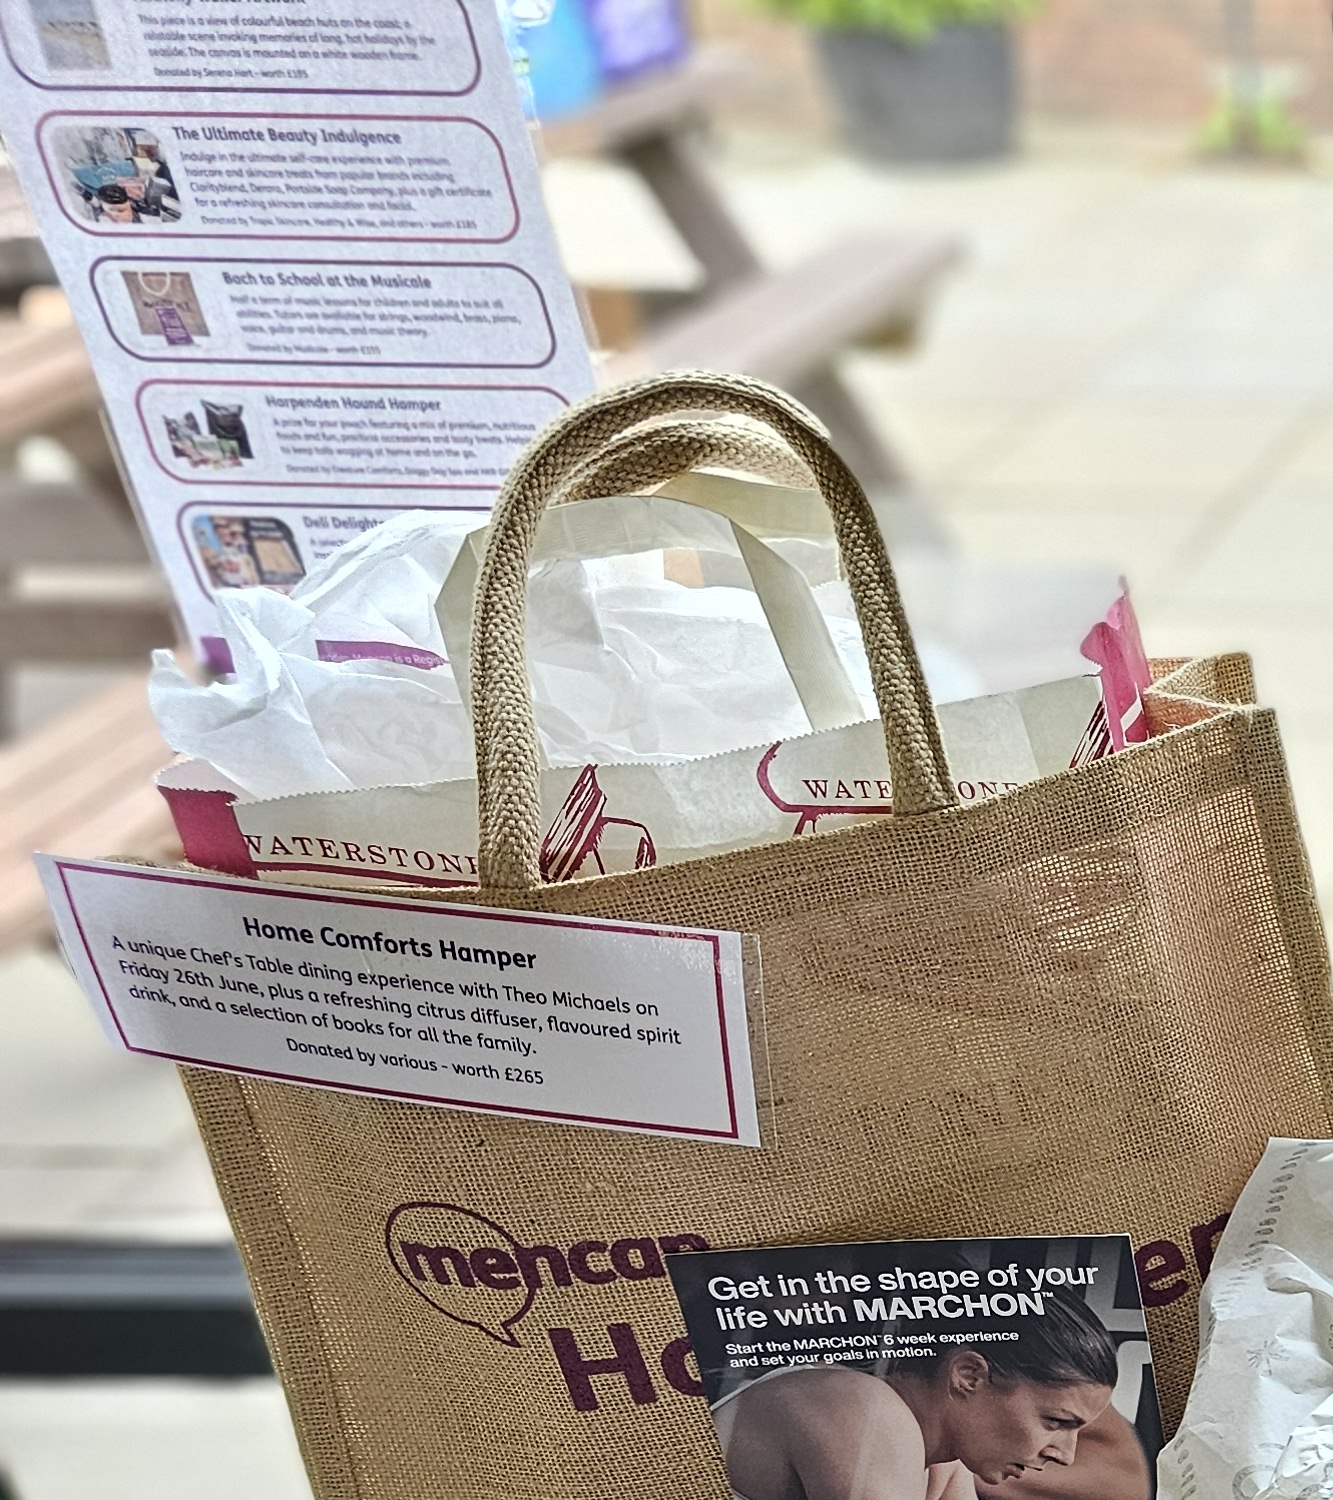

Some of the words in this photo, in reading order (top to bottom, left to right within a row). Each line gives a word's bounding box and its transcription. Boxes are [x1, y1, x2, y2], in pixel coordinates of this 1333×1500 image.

[242, 917, 314, 943] Home
[321, 927, 432, 957] Comforts
[439, 939, 536, 971] Hamper
[112, 935, 126, 951] A
[127, 940, 187, 961] unique
[190, 948, 243, 967] Chef's
[245, 954, 293, 975] Table
[298, 961, 352, 986] dining
[358, 970, 454, 994] experience
[459, 982, 498, 999] with
[502, 985, 547, 1004] Theo
[553, 991, 630, 1013] Michaels
[636, 1004, 658, 1016] on
[708, 1275, 774, 1302] Get
[777, 1275, 809, 1296] in
[815, 1271, 871, 1293] the
[878, 1267, 979, 1294] shape
[988, 1264, 1018, 1286] of
[1026, 1267, 1099, 1291] your
[716, 1306, 767, 1330] life
[773, 1301, 847, 1326] with
[725, 1343, 764, 1354] Start
[766, 1341, 791, 1352] the
[884, 1335, 894, 1345] 6
[897, 1333, 937, 1344] week
[939, 1332, 1019, 1344] experience
